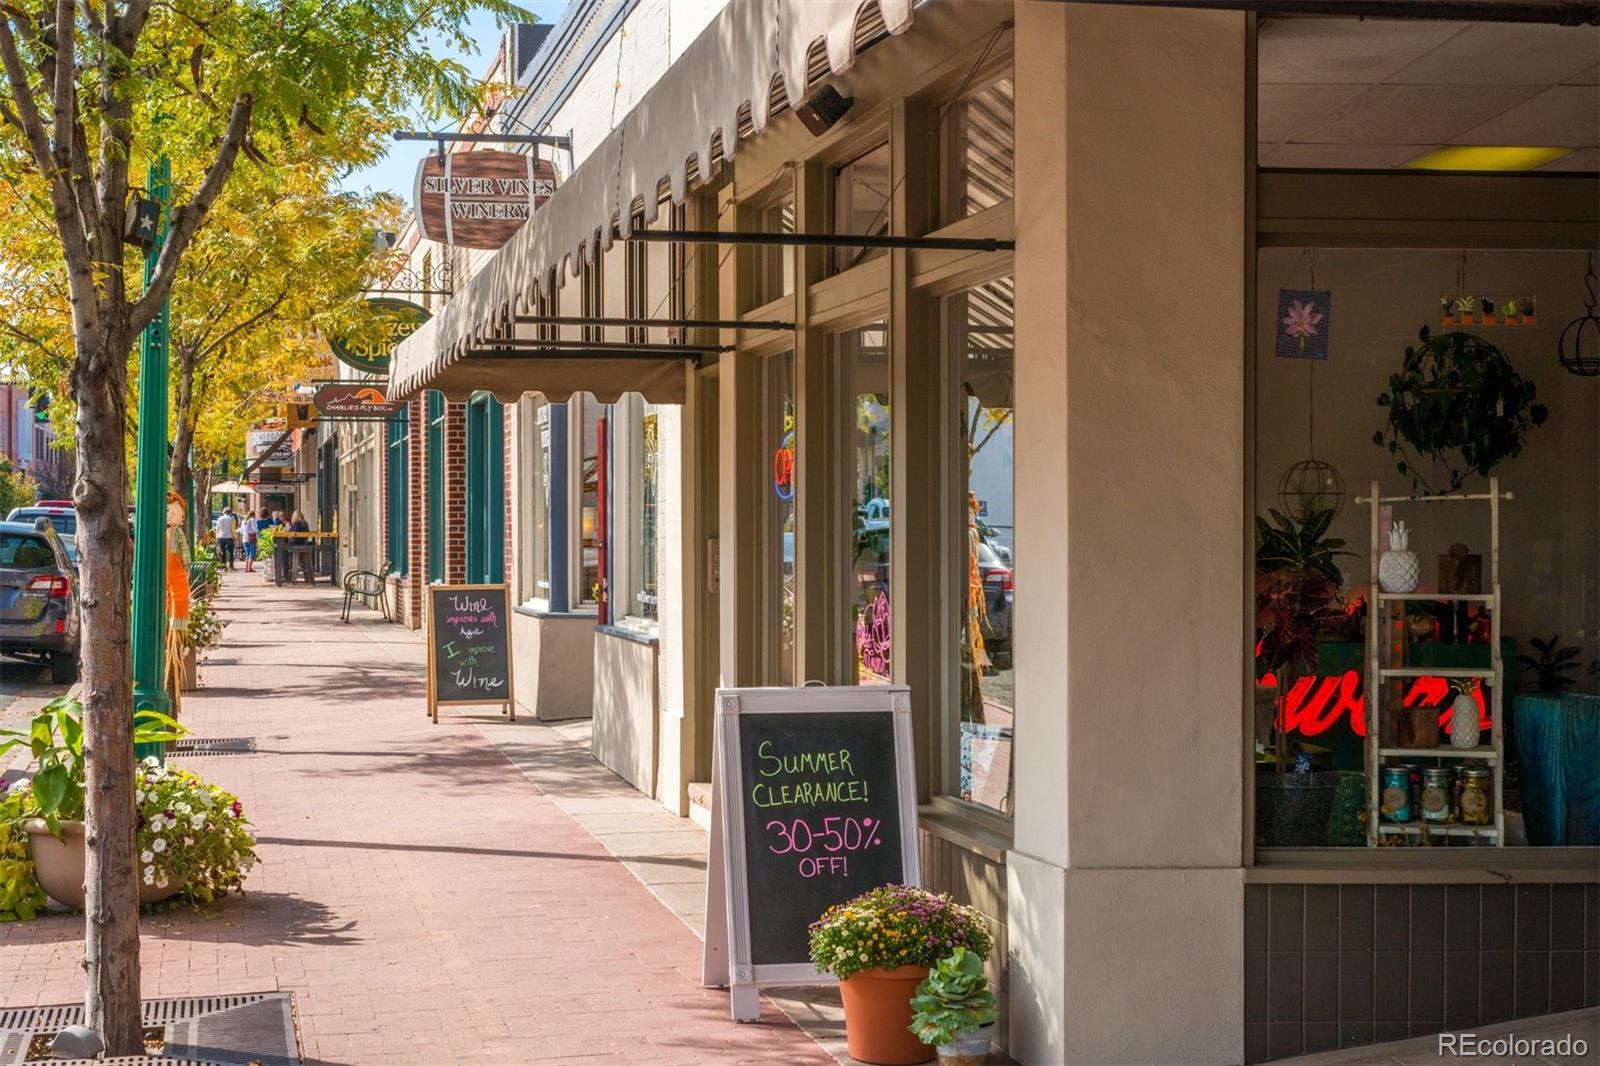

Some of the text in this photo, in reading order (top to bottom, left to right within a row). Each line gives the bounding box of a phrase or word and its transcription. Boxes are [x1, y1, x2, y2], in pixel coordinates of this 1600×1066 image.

[424, 176, 554, 197] SILVER VINES
[450, 202, 530, 220] WINERY
[360, 404, 372, 412] FLY
[449, 595, 493, 612] Wine
[442, 641, 496, 659] I improve
[459, 655, 479, 667] with
[451, 667, 504, 691] Wine
[758, 740, 855, 777] SUMMER
[752, 780, 869, 808] CLEARANCE!
[766, 816, 882, 854] 30-50%
[799, 856, 849, 878] OFF!
